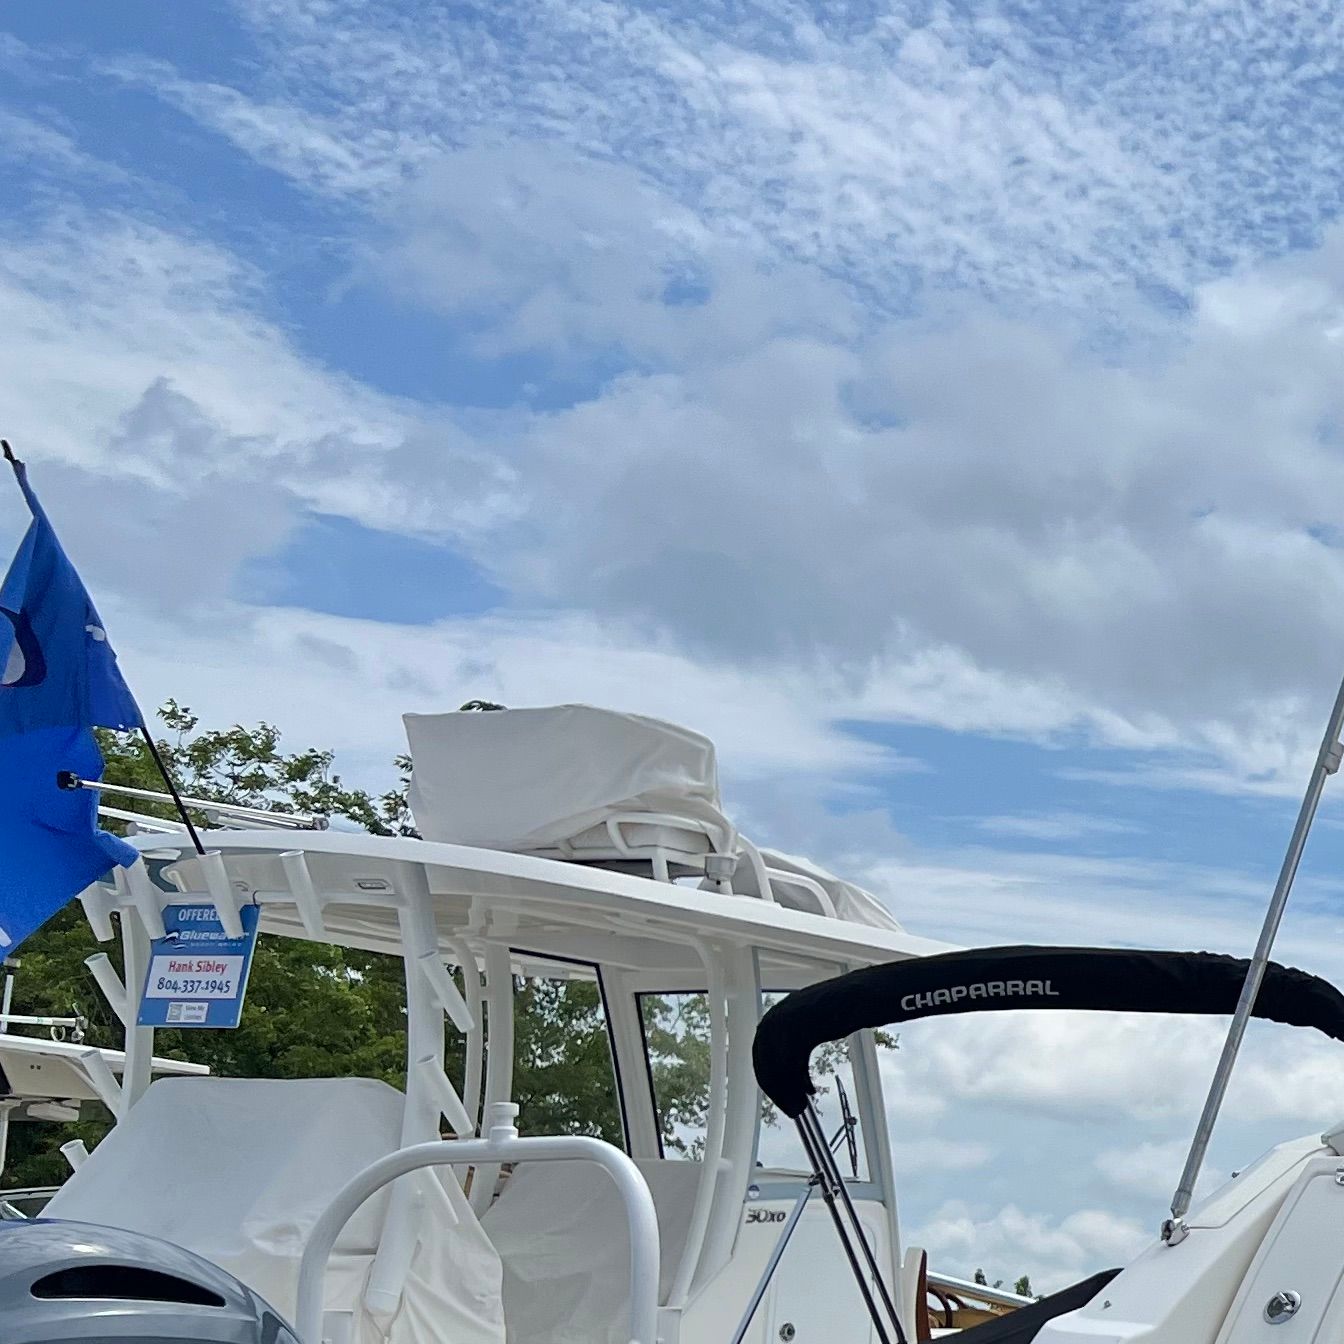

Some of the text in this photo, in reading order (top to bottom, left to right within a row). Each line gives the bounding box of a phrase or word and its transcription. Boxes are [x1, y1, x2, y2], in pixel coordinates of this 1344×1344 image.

[178, 909, 220, 921] OFFERE
[168, 960, 228, 976] Hank Sibley
[157, 976, 231, 994] 804-337-1945
[901, 980, 1060, 1011] CHAPARRAL
